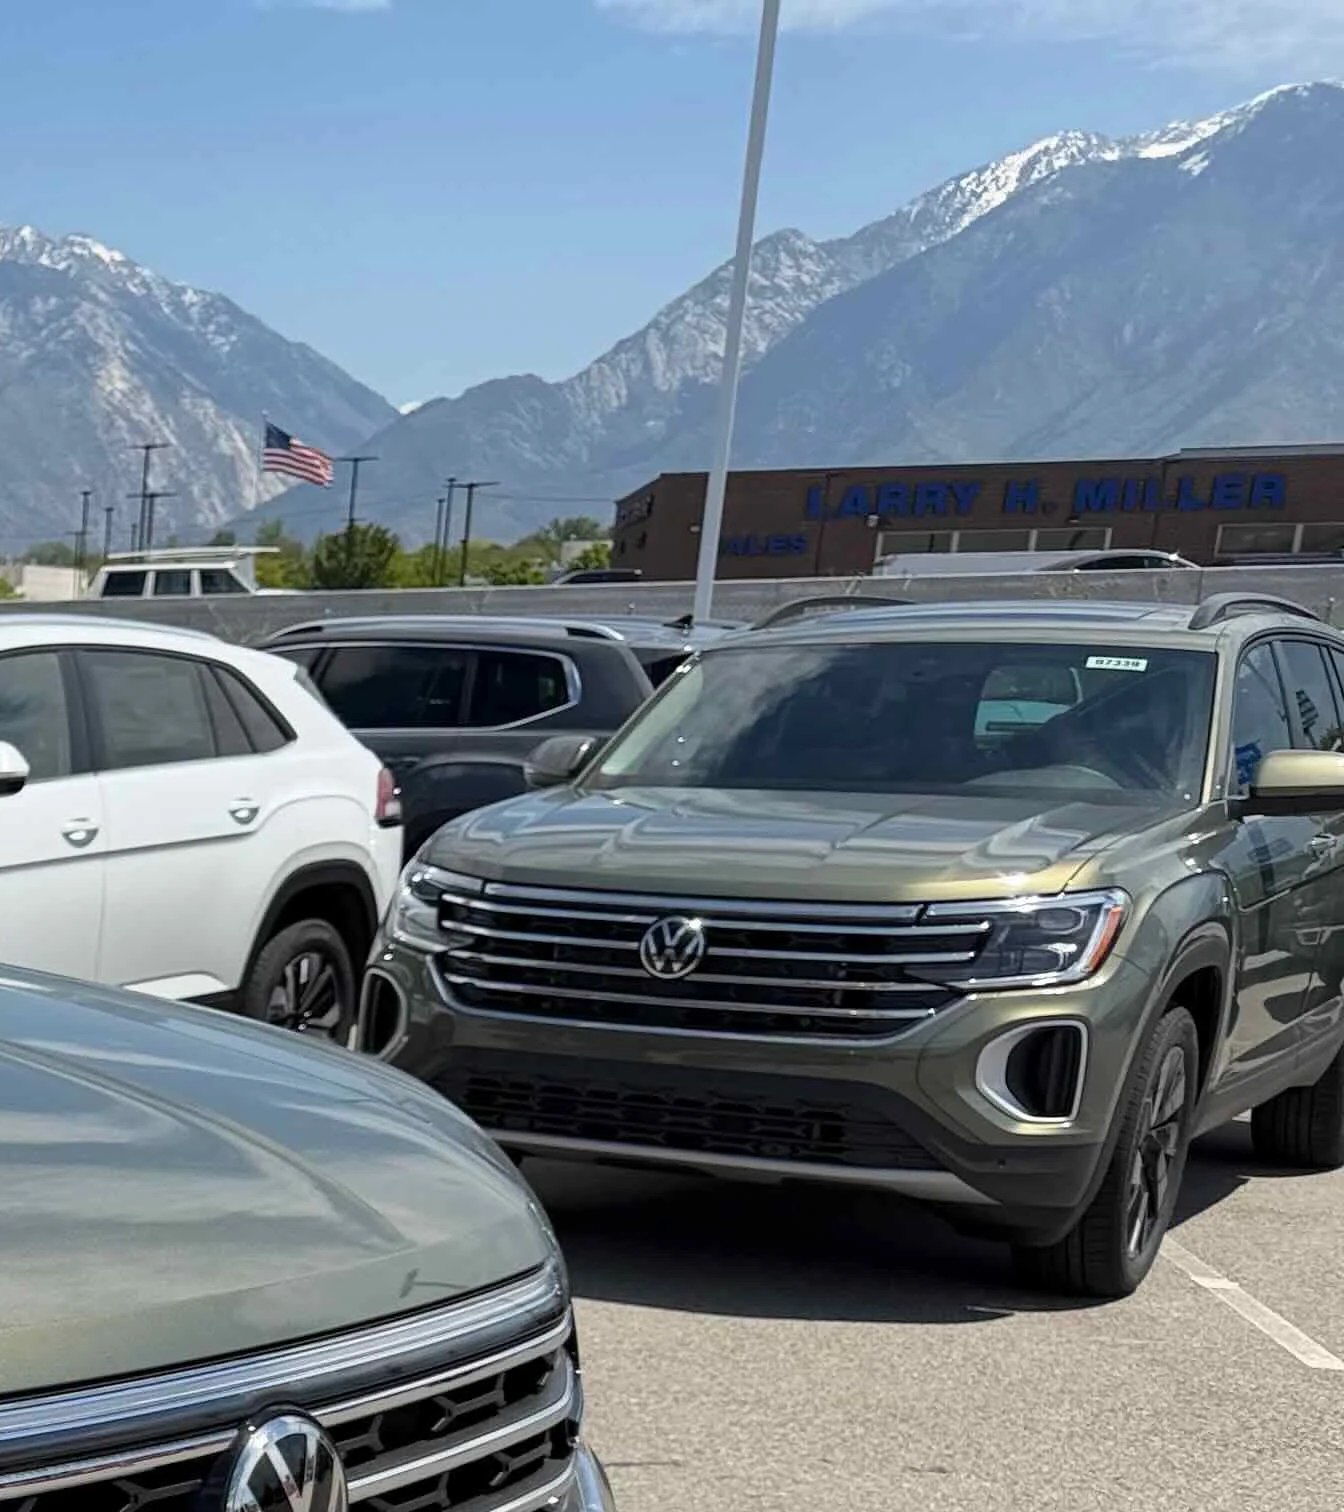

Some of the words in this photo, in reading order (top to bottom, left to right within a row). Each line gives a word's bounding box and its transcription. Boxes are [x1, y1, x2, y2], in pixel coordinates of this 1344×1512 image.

[805, 479, 982, 522] LARRY
[1003, 477, 1056, 515] H.
[1073, 473, 1287, 513] MILLER
[723, 532, 810, 556] ALES
